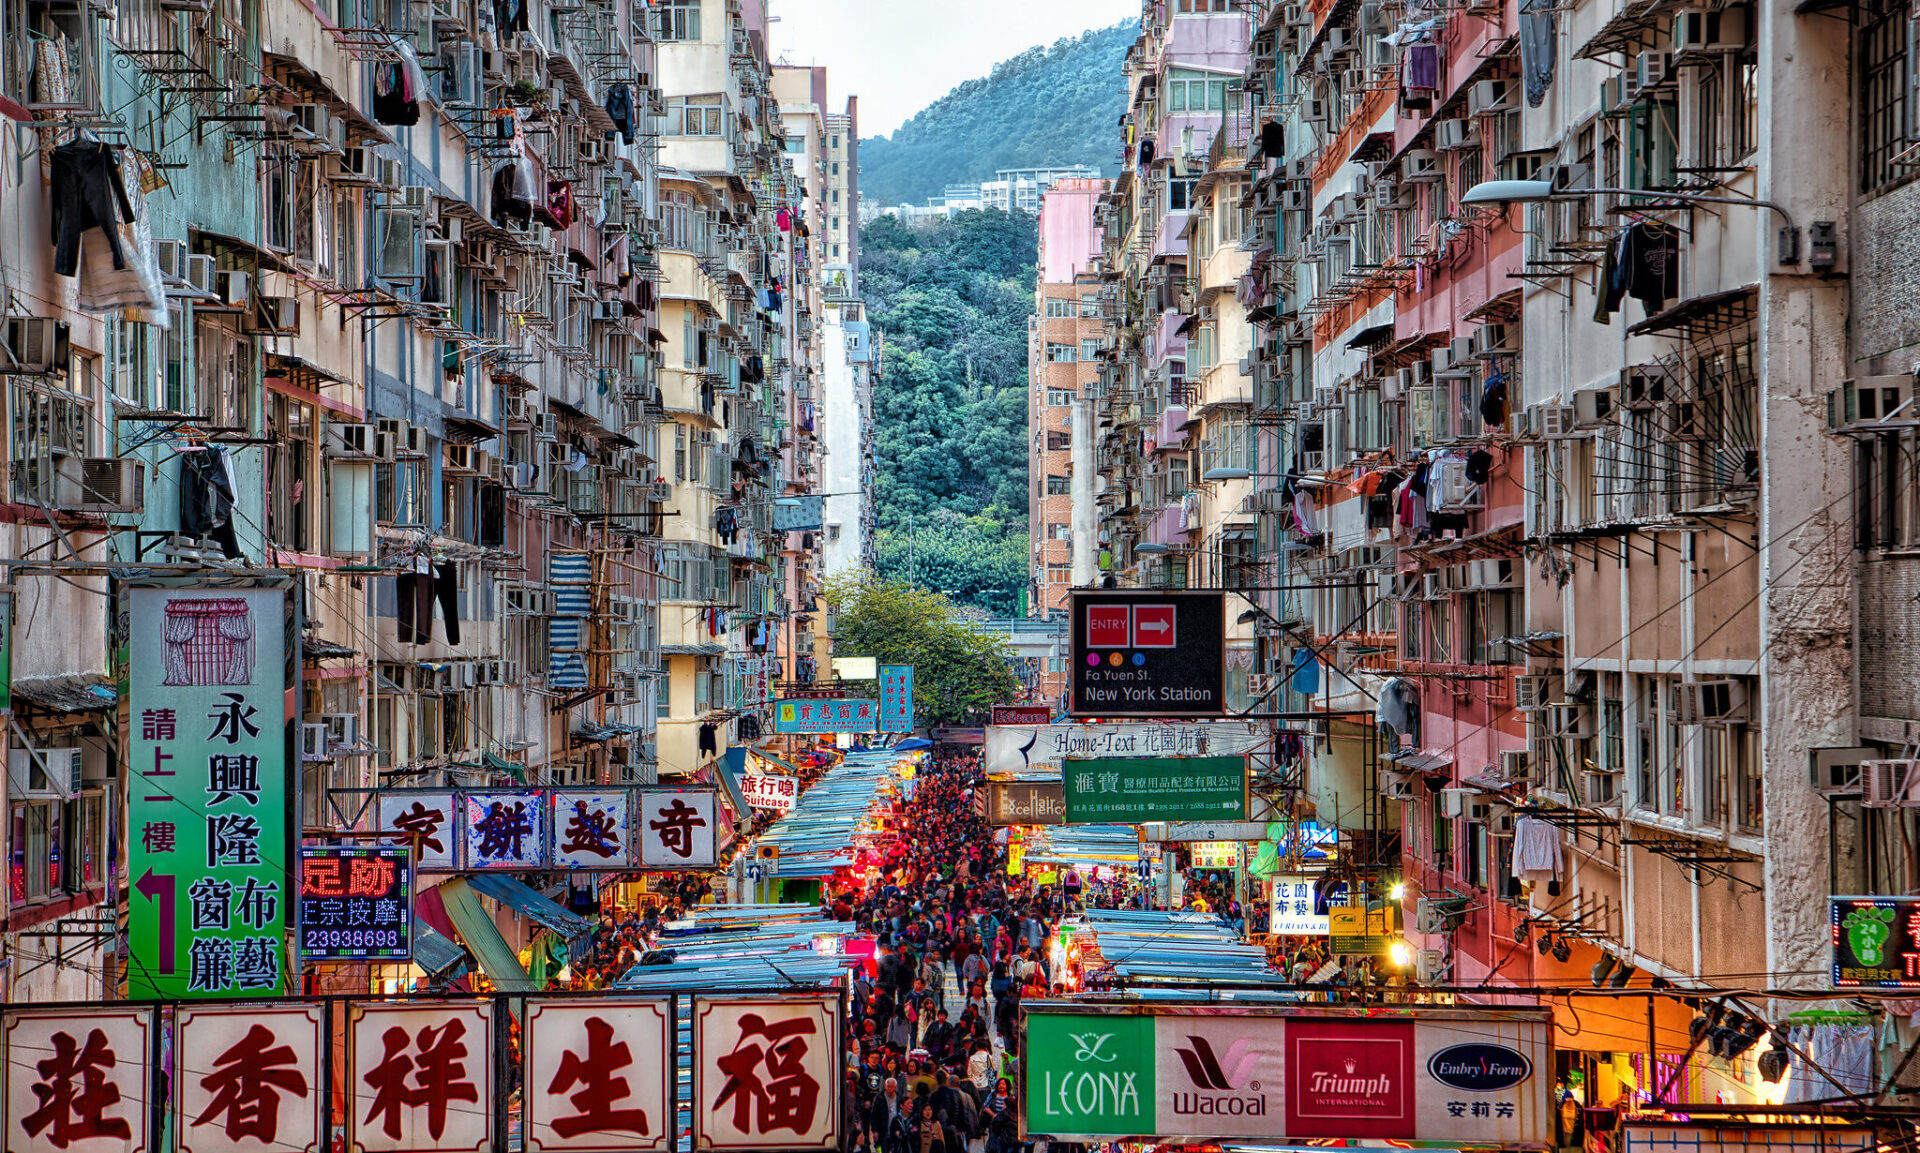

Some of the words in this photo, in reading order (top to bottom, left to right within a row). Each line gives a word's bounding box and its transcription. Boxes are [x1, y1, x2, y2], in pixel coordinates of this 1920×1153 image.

[1090, 619, 1127, 630] ENTRY
[1086, 670, 1100, 681] Fa
[1104, 670, 1133, 681] Yuen
[1137, 670, 1151, 681] St.
[1086, 687, 1118, 701] New
[1122, 687, 1156, 701] York
[1160, 687, 1211, 701] Station
[1055, 726, 1137, 752] Home-Text
[1143, 726, 1211, 752] 花園布藝
[142, 708, 177, 854] 請上一樓
[205, 692, 261, 869] 永興隆
[744, 794, 790, 808] Suitcase
[301, 857, 395, 896] 足跡
[1276, 882, 1307, 898] 花園
[1275, 899, 1308, 915] 布藝
[307, 929, 397, 948] 23938698
[1438, 1060, 1480, 1080] Embry
[1489, 1062, 1523, 1077] Form
[1310, 1071, 1391, 1097] Triumph
[1045, 1071, 1140, 1117] LEONA
[1315, 1098, 1387, 1107] INTERNATIONAL
[1172, 1092, 1266, 1116] Wacoal
[1447, 1101, 1515, 1118] 安莉芳
